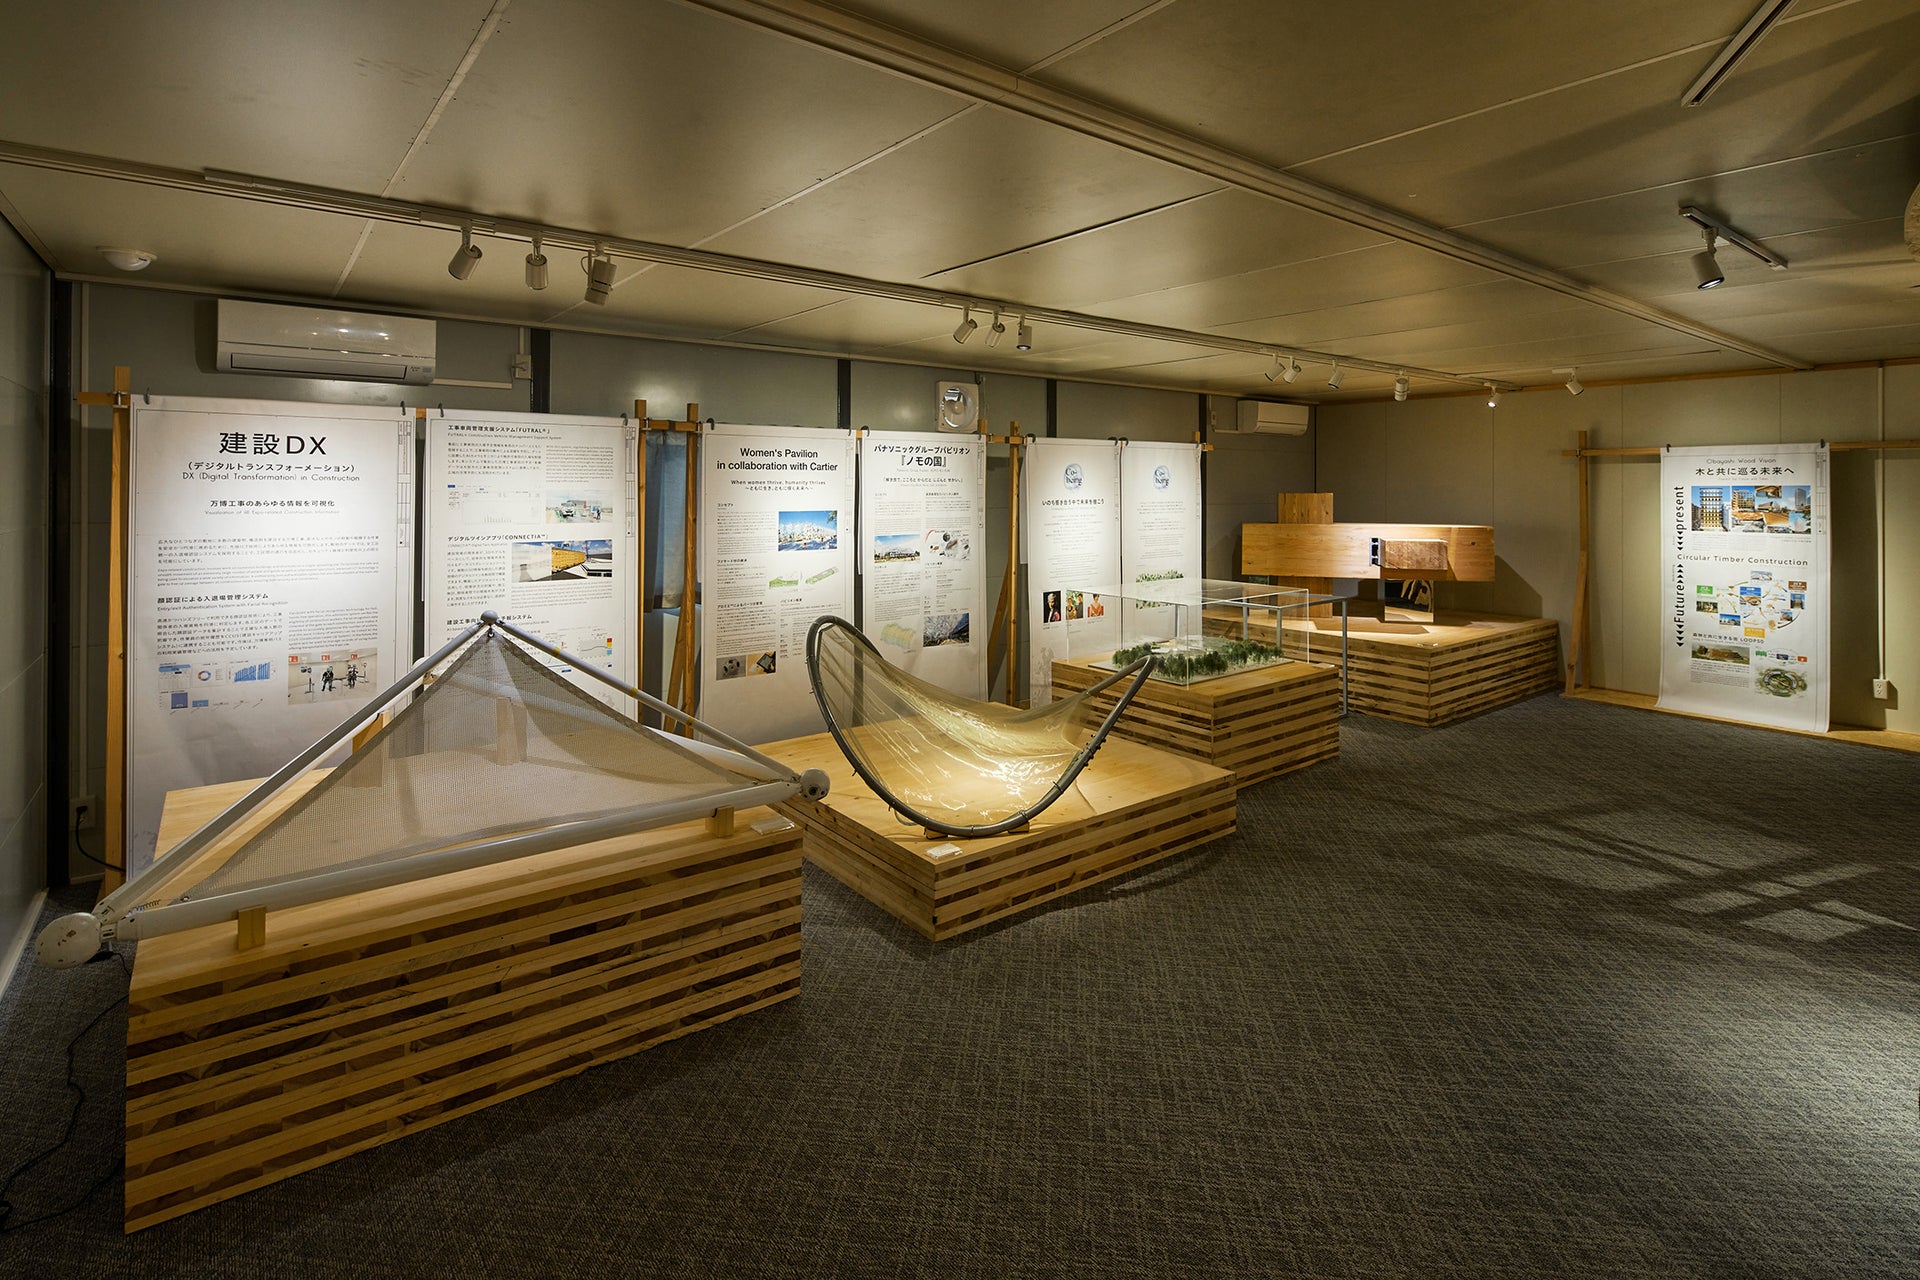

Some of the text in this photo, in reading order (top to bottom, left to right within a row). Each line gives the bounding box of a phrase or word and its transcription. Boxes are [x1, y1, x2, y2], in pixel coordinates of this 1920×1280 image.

[219, 432, 327, 456] 建設DX
[874, 444, 970, 454] パナソニックグループパビリオン
[740, 448, 818, 458] Women's Pavilion
[717, 461, 838, 472] in collaboration with Cartier
[902, 455, 946, 467] 『ノモの国』
[1696, 466, 1794, 476] 木と共に巡る未来へ
[182, 472, 194, 480] DX
[199, 472, 229, 482] (Digital
[234, 473, 298, 482] Transformation)
[311, 474, 360, 482] Construction
[1674, 486, 1687, 530] present
[1749, 557, 1808, 566] Construction
[157, 593, 268, 604] 顔認証による入退場管理システム
[1674, 584, 1684, 623] Future
